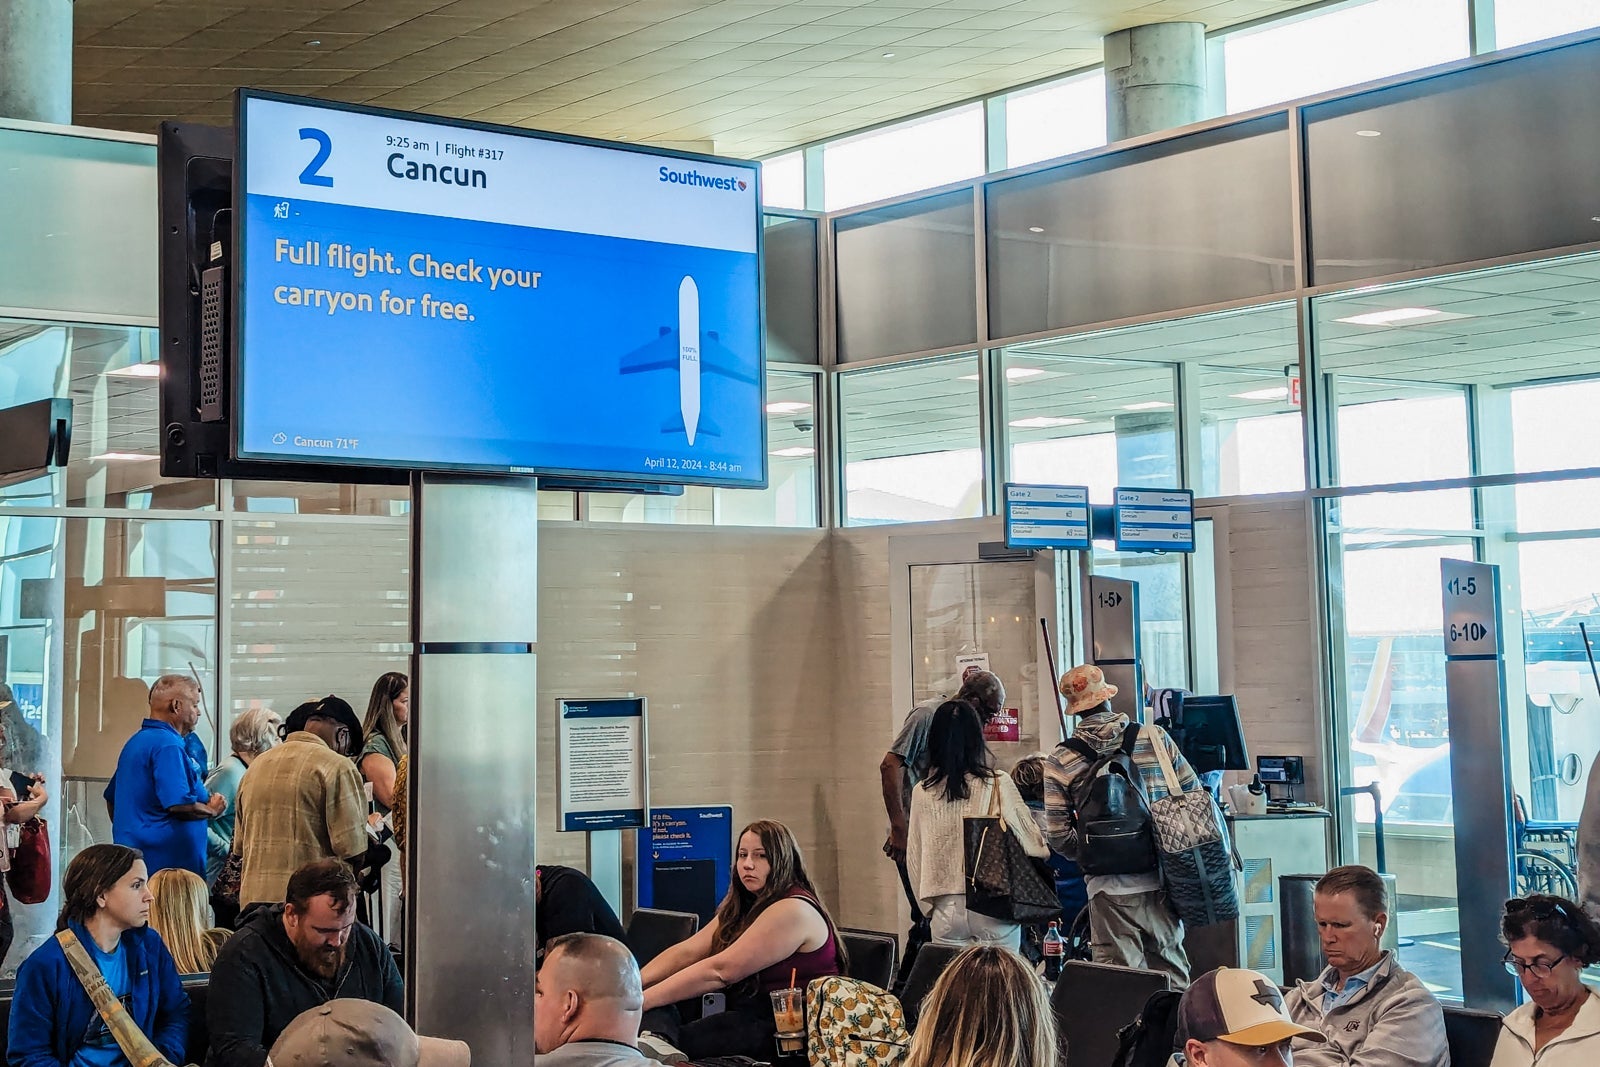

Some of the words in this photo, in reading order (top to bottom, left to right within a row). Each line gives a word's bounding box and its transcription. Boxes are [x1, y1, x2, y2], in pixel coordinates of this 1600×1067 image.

[298, 128, 334, 188] 2
[386, 135, 410, 149] 9:25
[413, 141, 430, 152] am
[445, 144, 476, 159] Flight
[478, 148, 504, 161] #317
[386, 153, 487, 188] Cancun
[659, 166, 737, 192] Southwest
[274, 238, 320, 266] Full
[326, 244, 402, 278] flight.
[408, 254, 483, 284] Check
[487, 267, 542, 291] your
[273, 285, 373, 316] carryon
[380, 290, 416, 316] for
[420, 293, 476, 322] free.
[294, 436, 334, 448] Cancun
[644, 457, 665, 469] April
[666, 458, 680, 470] 12,
[681, 459, 702, 470] 2024
[709, 461, 727, 472] 8:44
[728, 463, 742, 472] am
[1453, 576, 1476, 596] 1-5
[1098, 592, 1116, 608] 1-5
[1450, 622, 1480, 642] 6-10
